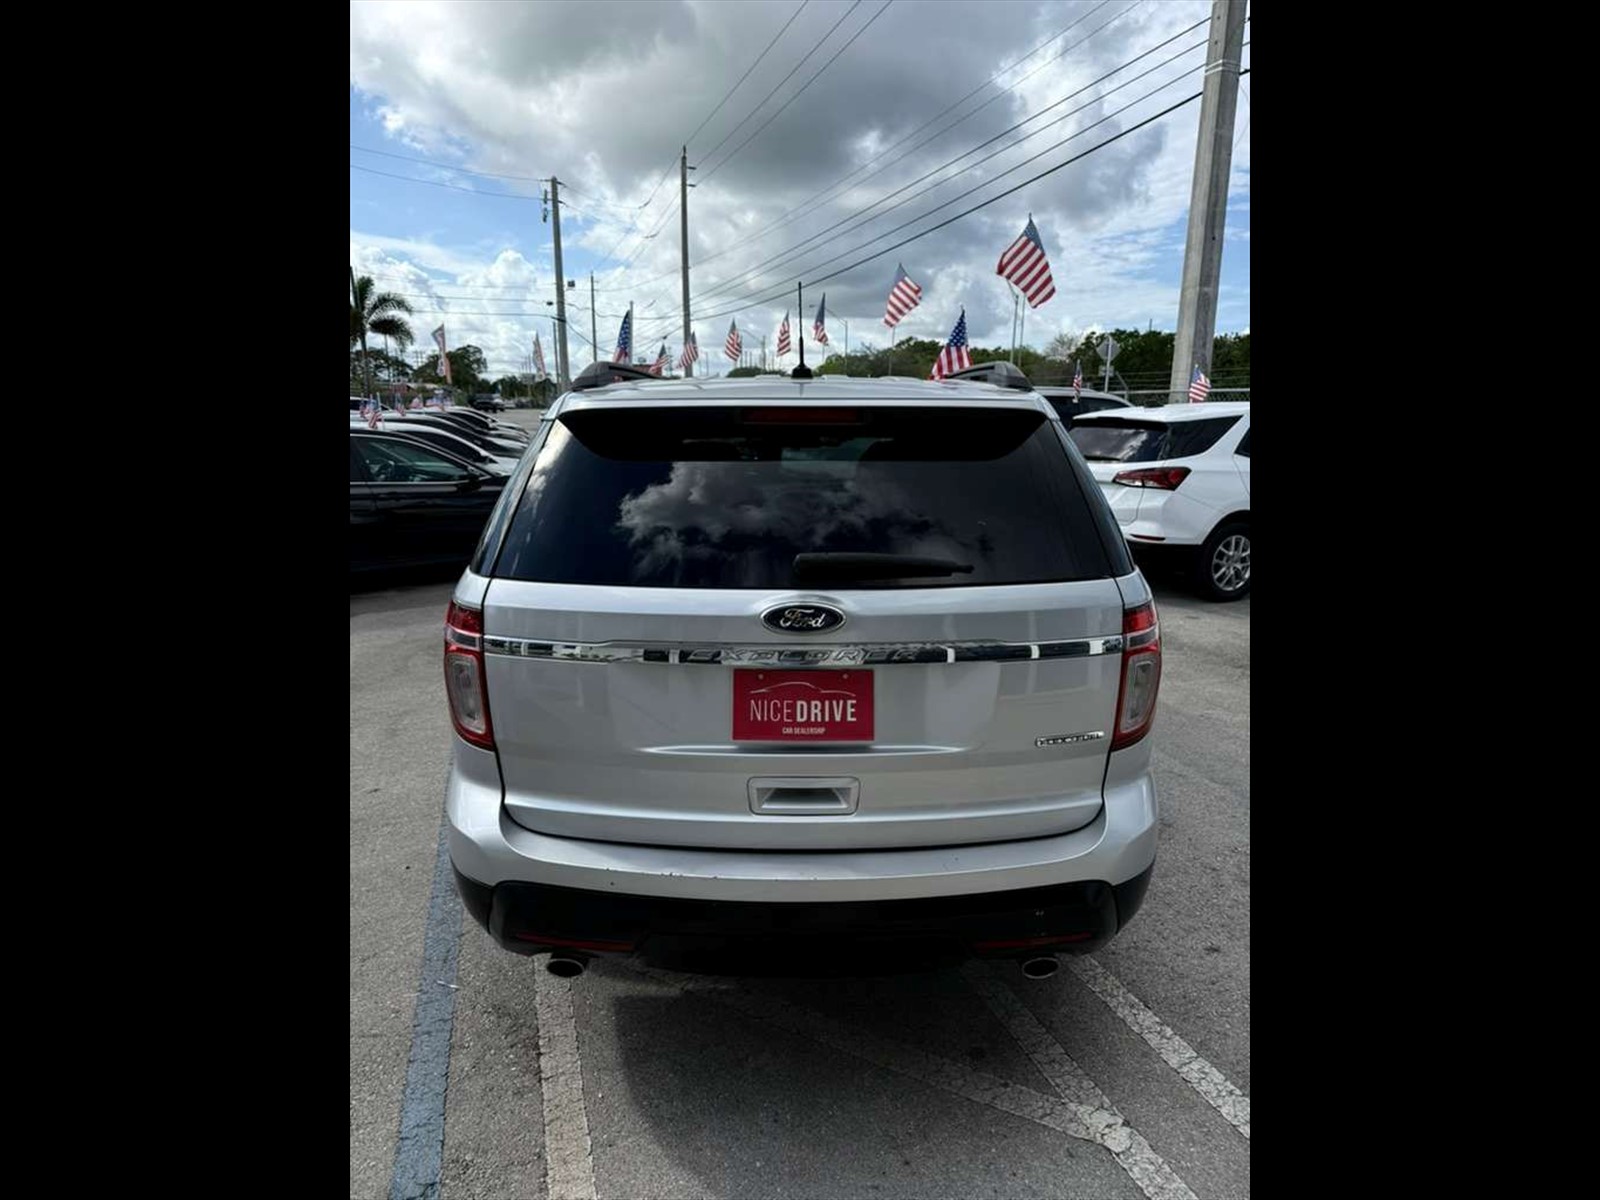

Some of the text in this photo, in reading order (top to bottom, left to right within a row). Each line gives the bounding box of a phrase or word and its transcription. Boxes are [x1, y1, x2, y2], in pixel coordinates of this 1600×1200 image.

[780, 608, 826, 628] Ford
[687, 649, 918, 662] EXPLORER
[782, 726, 826, 735] CAR DEALERSHIP
